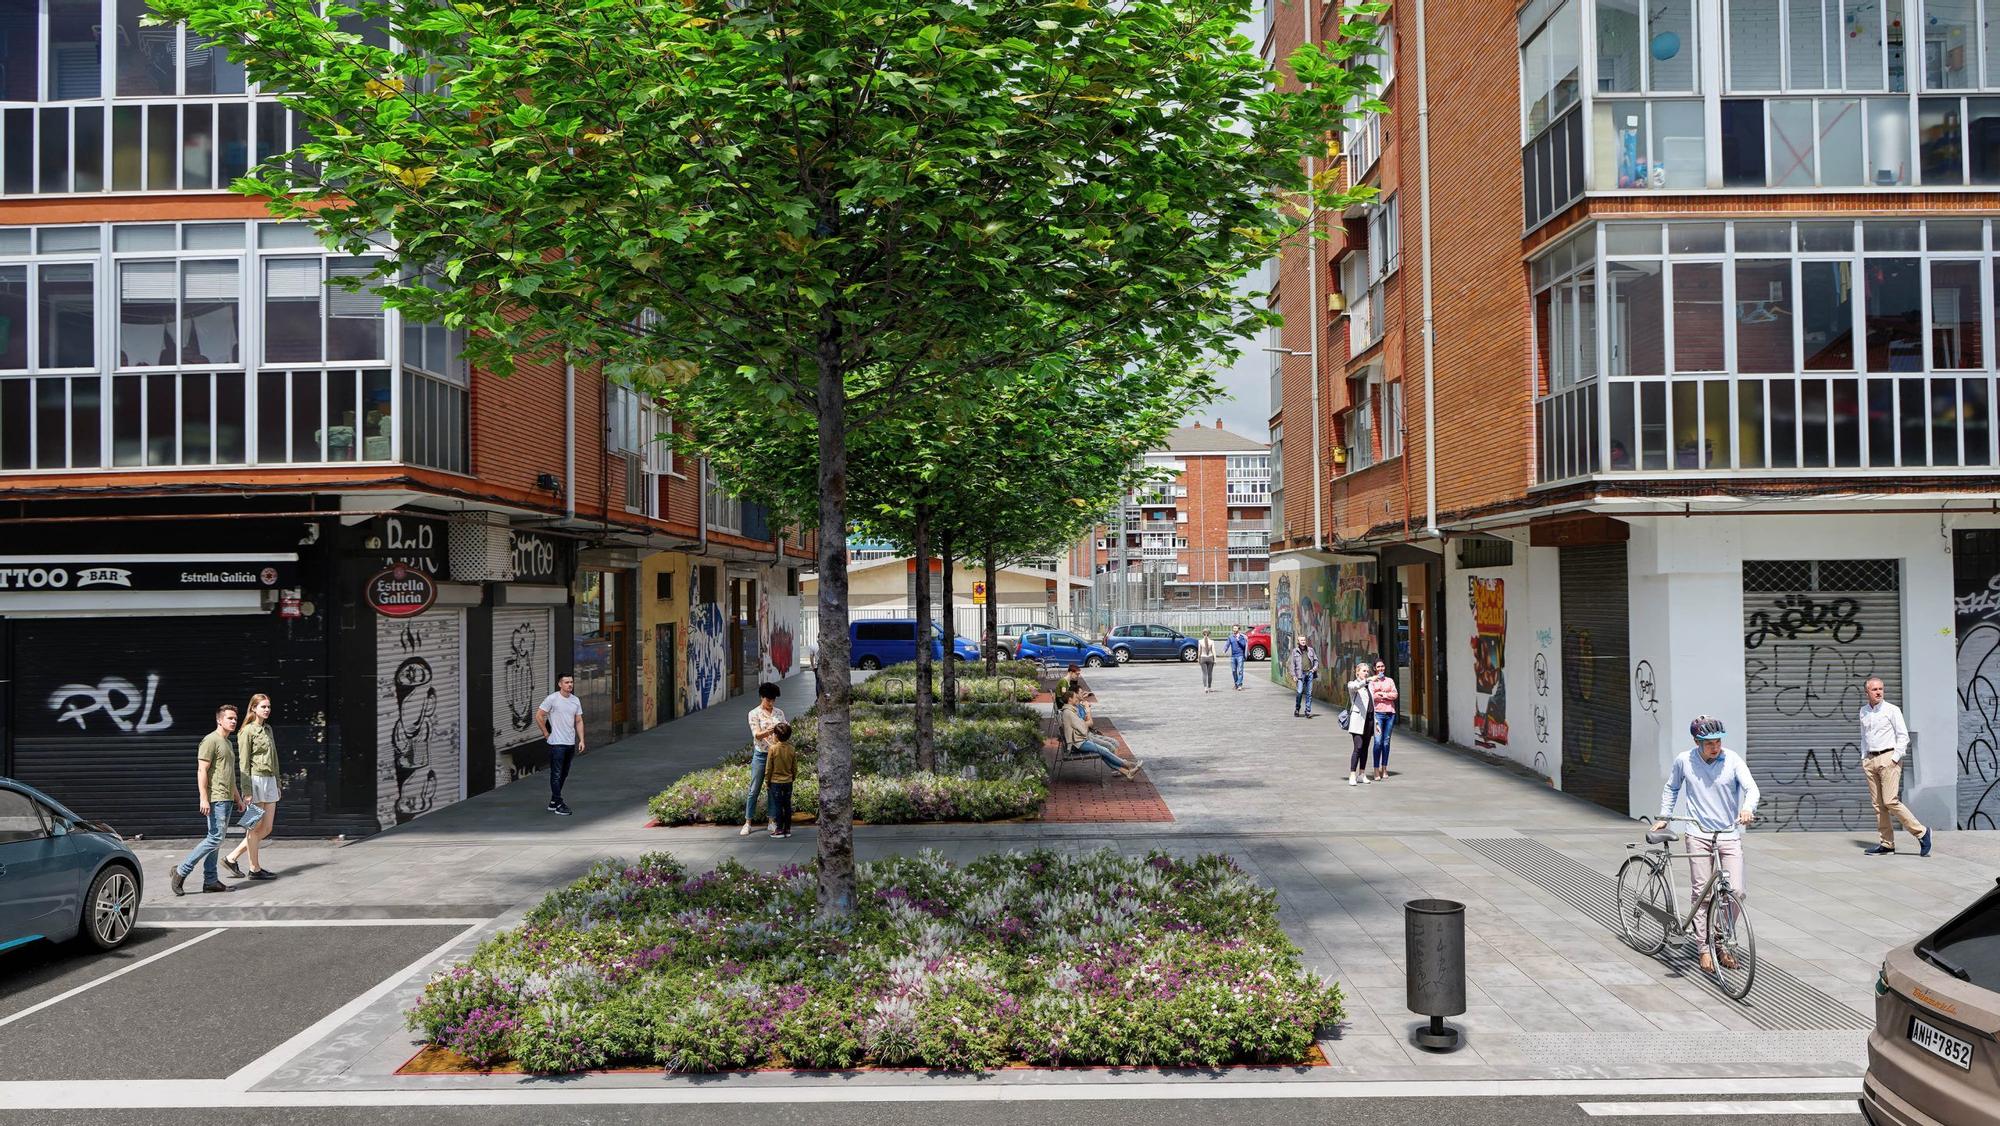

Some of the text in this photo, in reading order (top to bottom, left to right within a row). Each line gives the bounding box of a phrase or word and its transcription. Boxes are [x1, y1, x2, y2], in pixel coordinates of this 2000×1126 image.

[89, 570, 119, 581] BAR
[180, 571, 257, 583] Estrella Galicia
[376, 578, 425, 592] Estrella
[378, 592, 423, 605] Galicia
